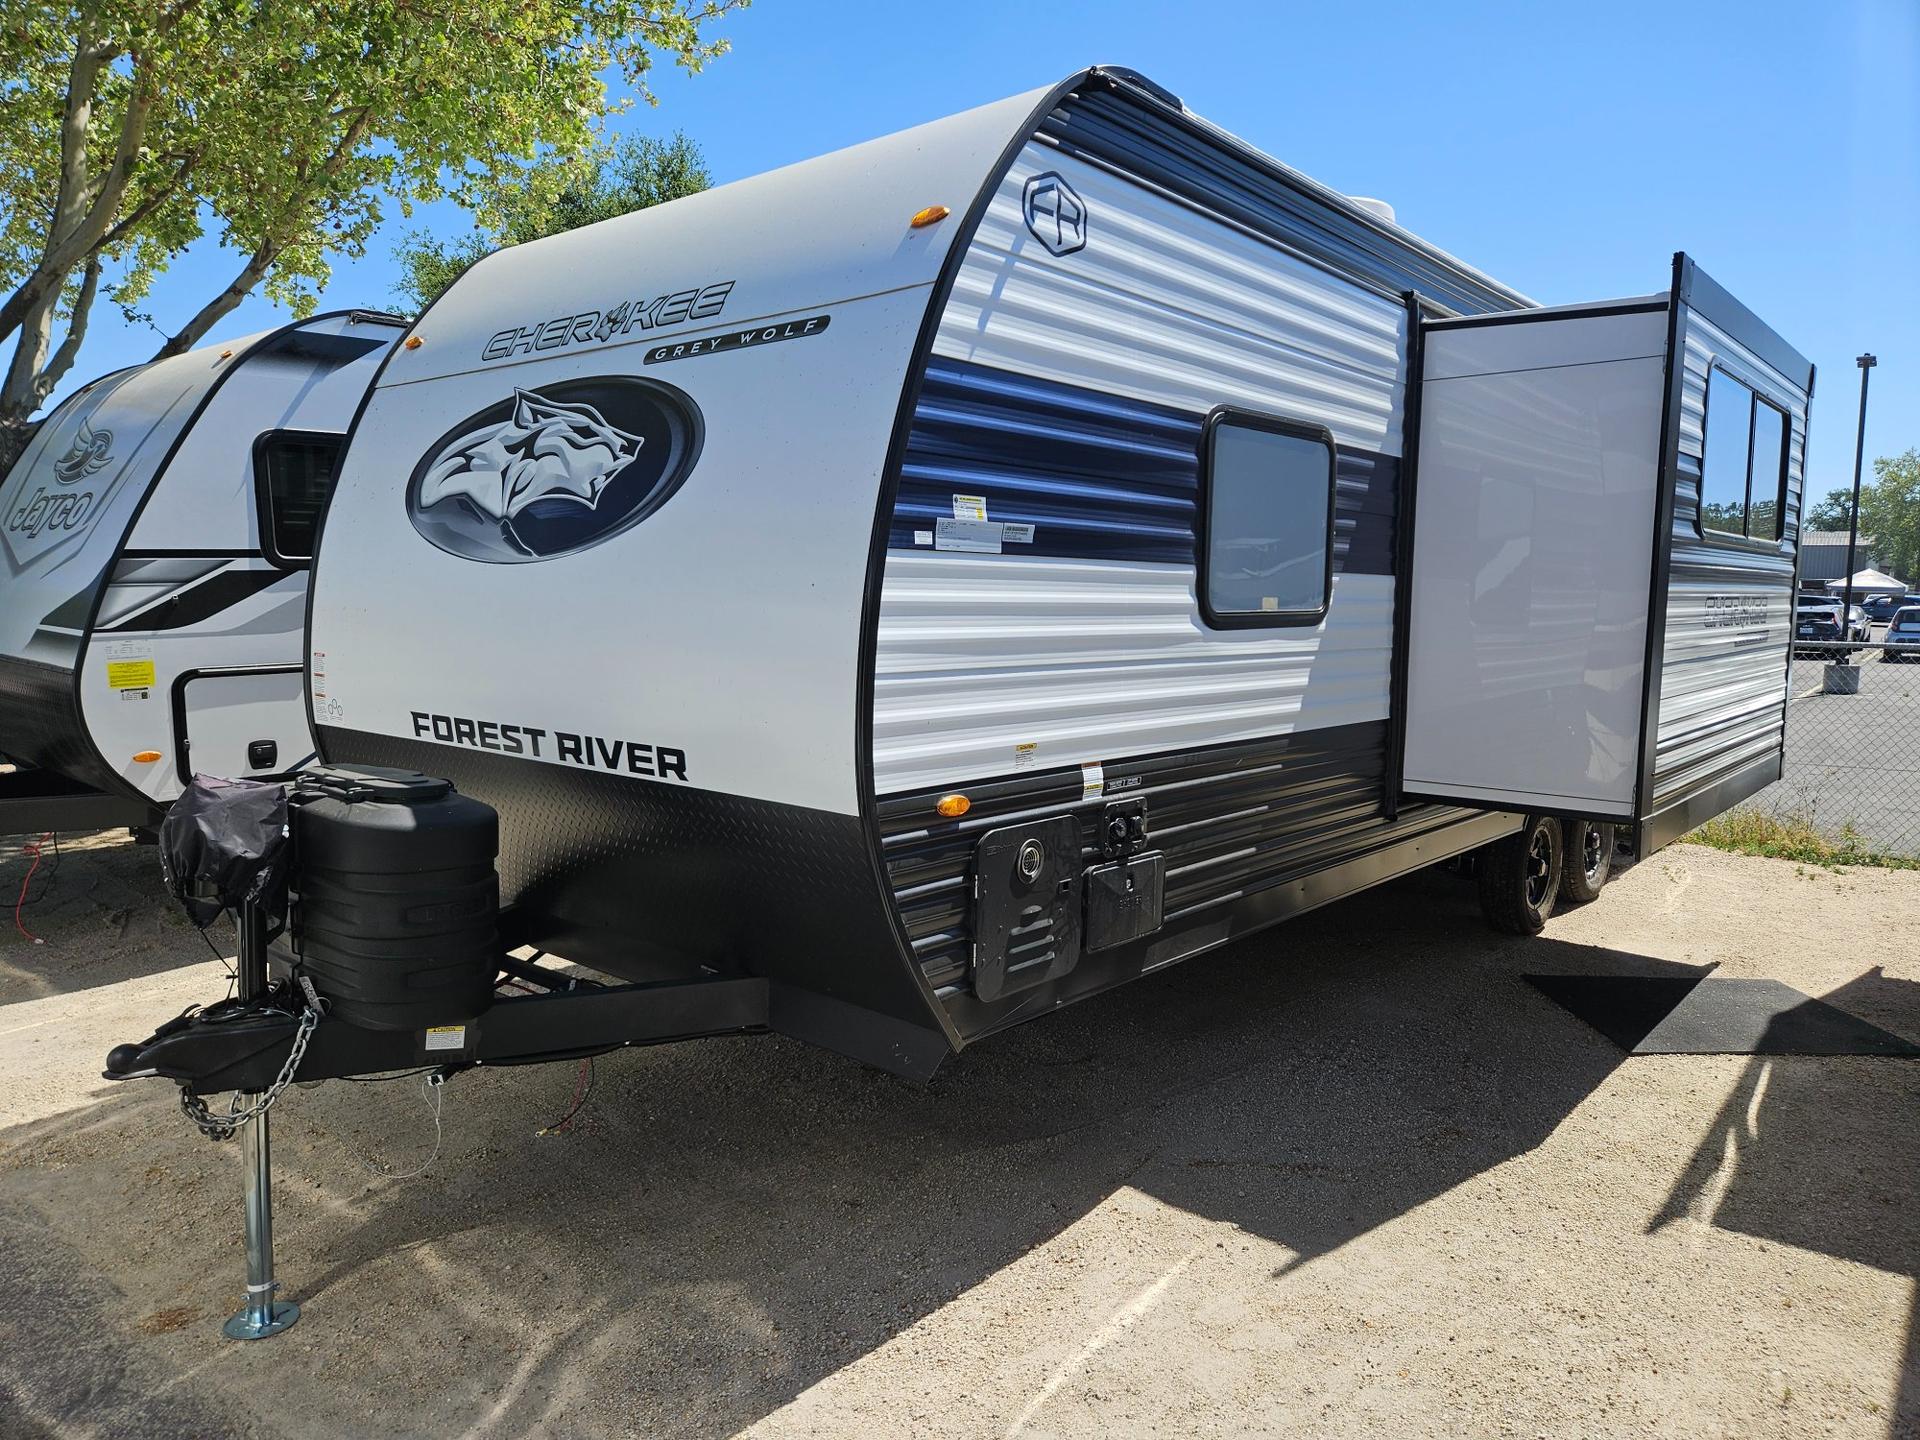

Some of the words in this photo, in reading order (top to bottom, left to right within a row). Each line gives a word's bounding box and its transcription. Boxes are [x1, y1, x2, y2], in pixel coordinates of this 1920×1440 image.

[654, 338, 723, 360] GREY
[739, 319, 819, 345] WOLF
[410, 711, 546, 758] FOREST
[554, 731, 689, 782] RIVER
